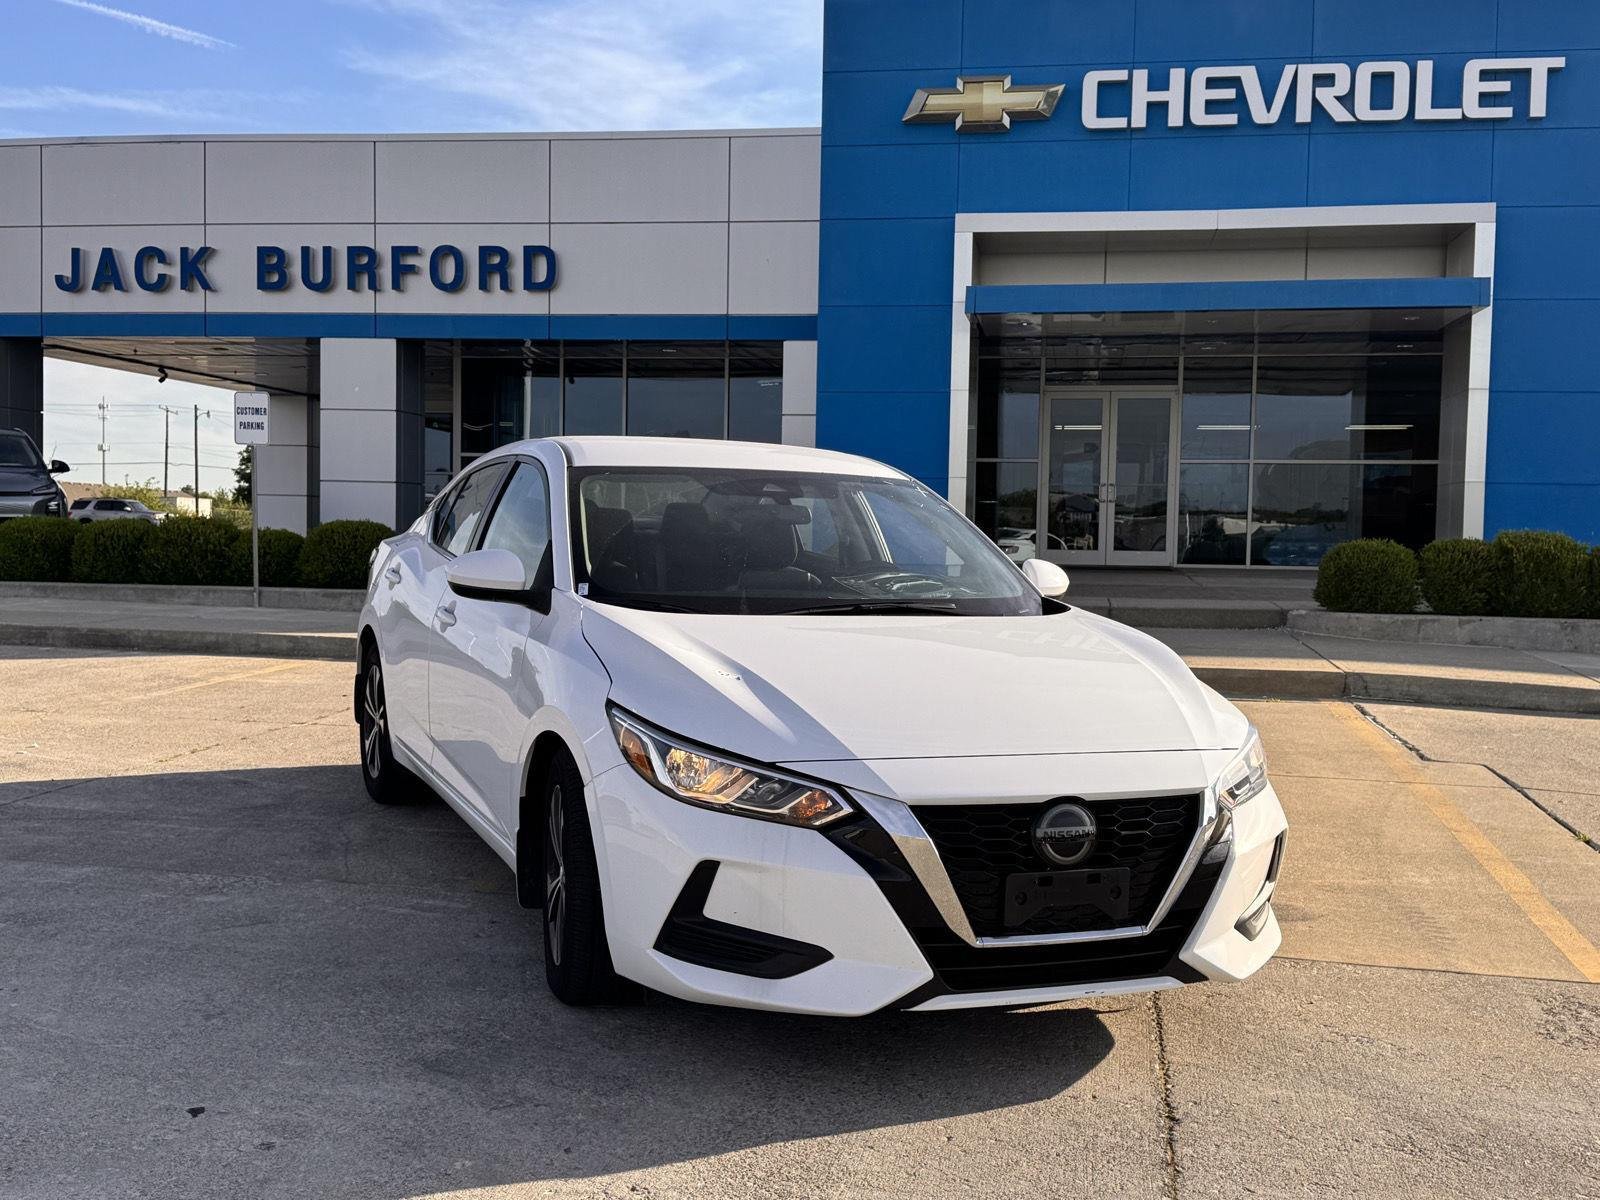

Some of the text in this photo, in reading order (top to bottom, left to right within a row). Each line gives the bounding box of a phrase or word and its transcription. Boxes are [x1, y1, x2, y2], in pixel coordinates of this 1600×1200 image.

[1081, 56, 1566, 130] CHEVROLET
[54, 244, 558, 293] JACK BURFORD
[236, 406, 268, 416] CUSTOMER
[239, 421, 265, 431] PARKING
[1043, 829, 1090, 839] NISSAN
